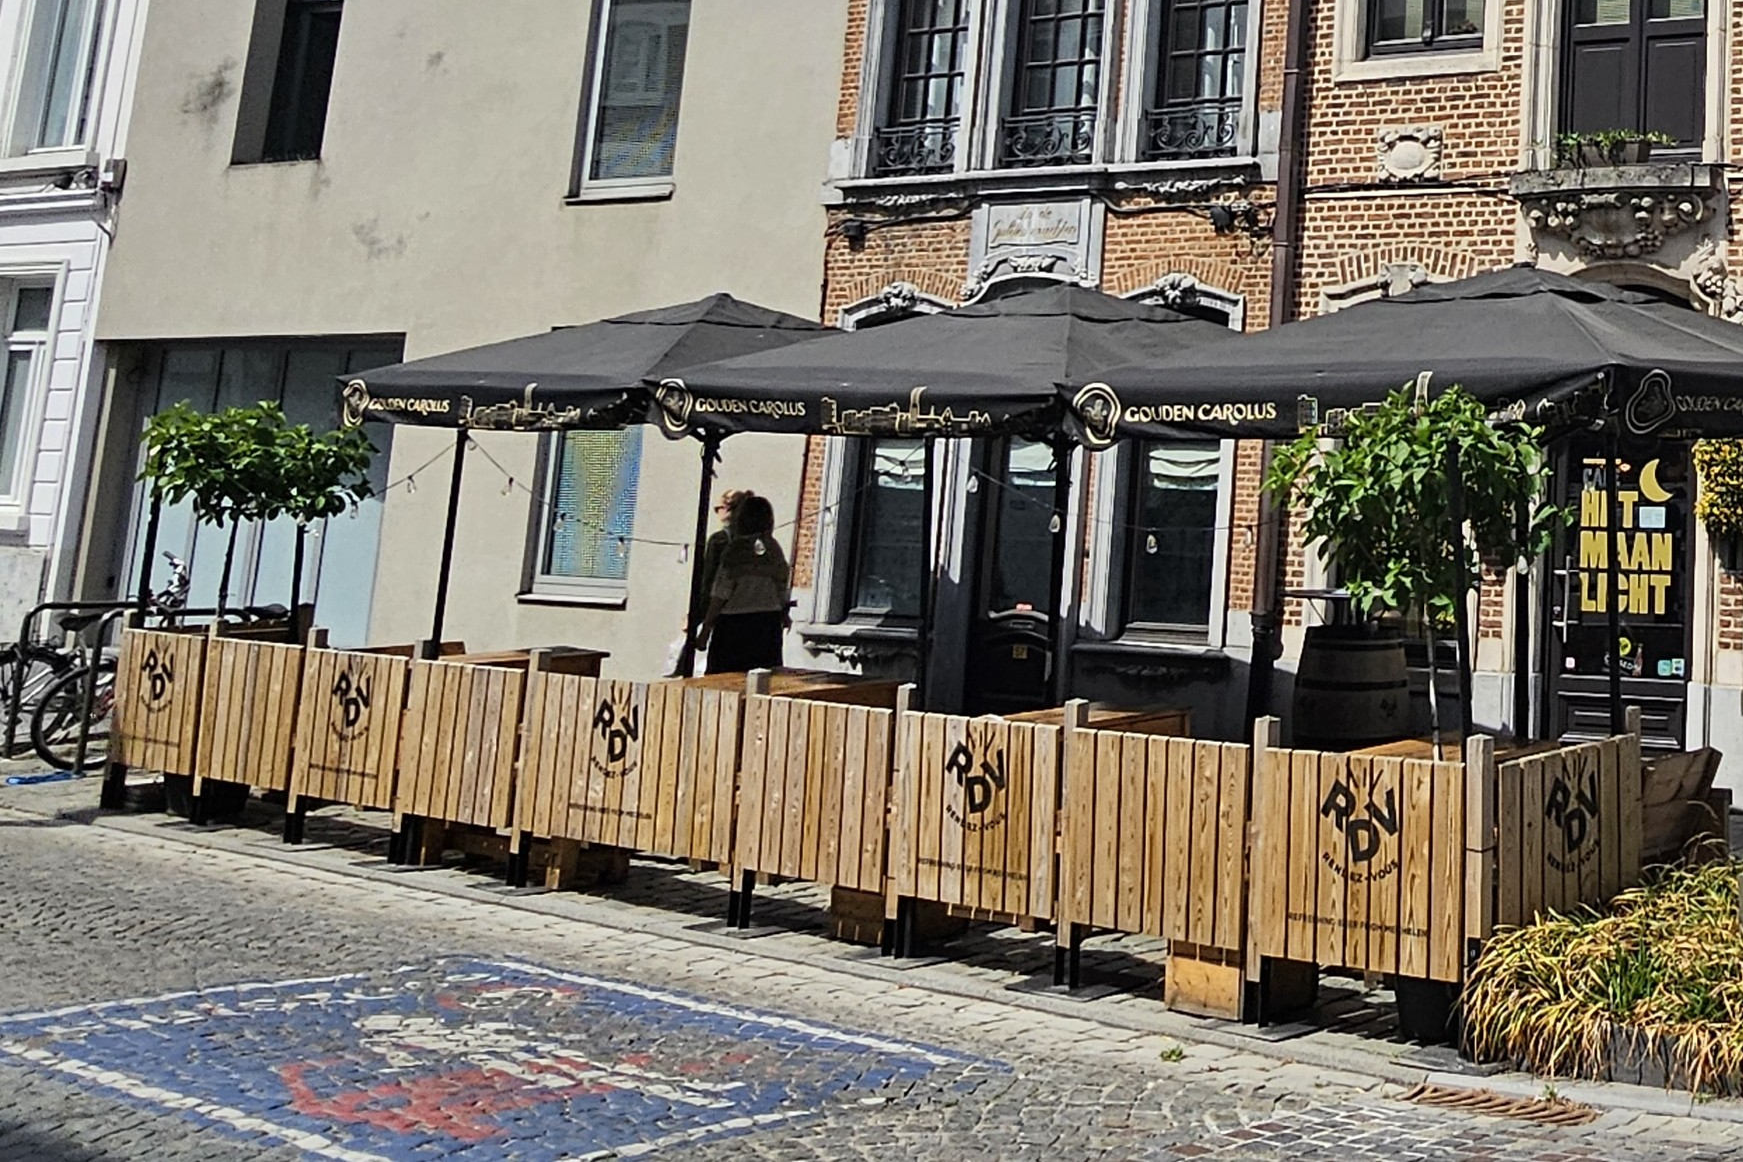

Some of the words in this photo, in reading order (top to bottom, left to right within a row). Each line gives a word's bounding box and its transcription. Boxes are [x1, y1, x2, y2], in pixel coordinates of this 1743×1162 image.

[406, 398, 450, 416] CAROLUS
[694, 397, 748, 413] GOUDEN
[749, 399, 806, 419] CAROLUS
[1124, 404, 1195, 423] GOUDEN
[1197, 401, 1278, 426] CAROLUS
[1579, 530, 1673, 571] MAAN
[592, 698, 639, 763] RDV
[945, 740, 1006, 814] RDV
[1320, 777, 1399, 863] RDV
[1545, 769, 1600, 854] RDV
